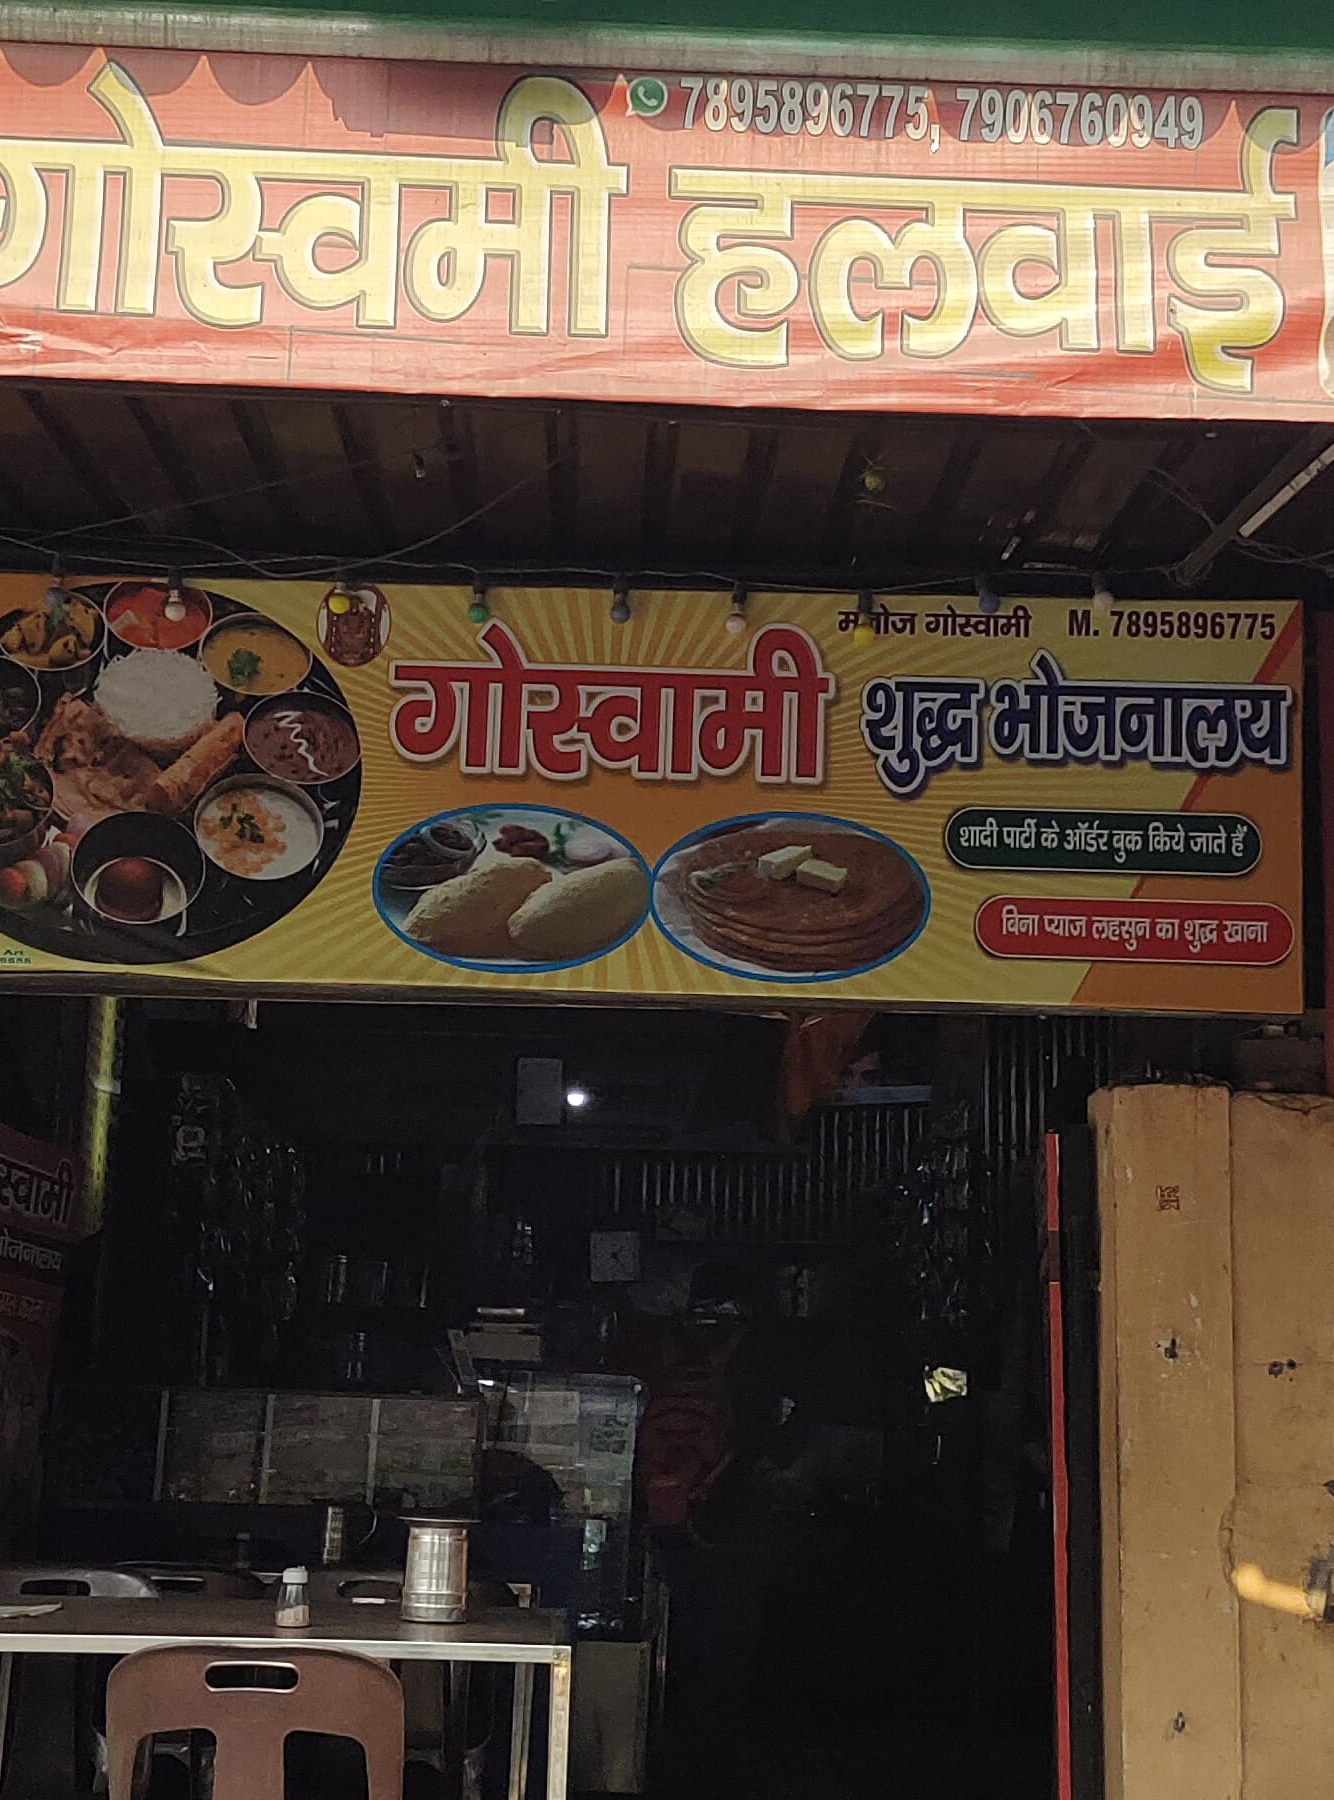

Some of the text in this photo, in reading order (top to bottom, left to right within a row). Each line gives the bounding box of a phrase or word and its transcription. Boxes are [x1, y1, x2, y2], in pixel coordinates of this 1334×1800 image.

[679, 76, 1205, 154] 7895896775, 7906760949
[667, 106, 1300, 395] हलवाई
[924, 604, 1033, 639] गोस्वामी
[1068, 609, 1277, 641] M. 7895896775
[390, 618, 835, 785] गोस्वामी
[861, 649, 1293, 794] शुद्ध भोजनालय
[959, 816, 999, 849] शादी
[1003, 817, 1038, 849] पार्टी
[1039, 819, 1061, 849] के
[1063, 819, 1110, 853] ऑर्डर
[1147, 821, 1186, 854] किये
[1188, 824, 1228, 855] जाते
[1230, 823, 1249, 858] हैं
[1001, 903, 1269, 954] बिना प्याज लहसुन का शुद्ध खाना
